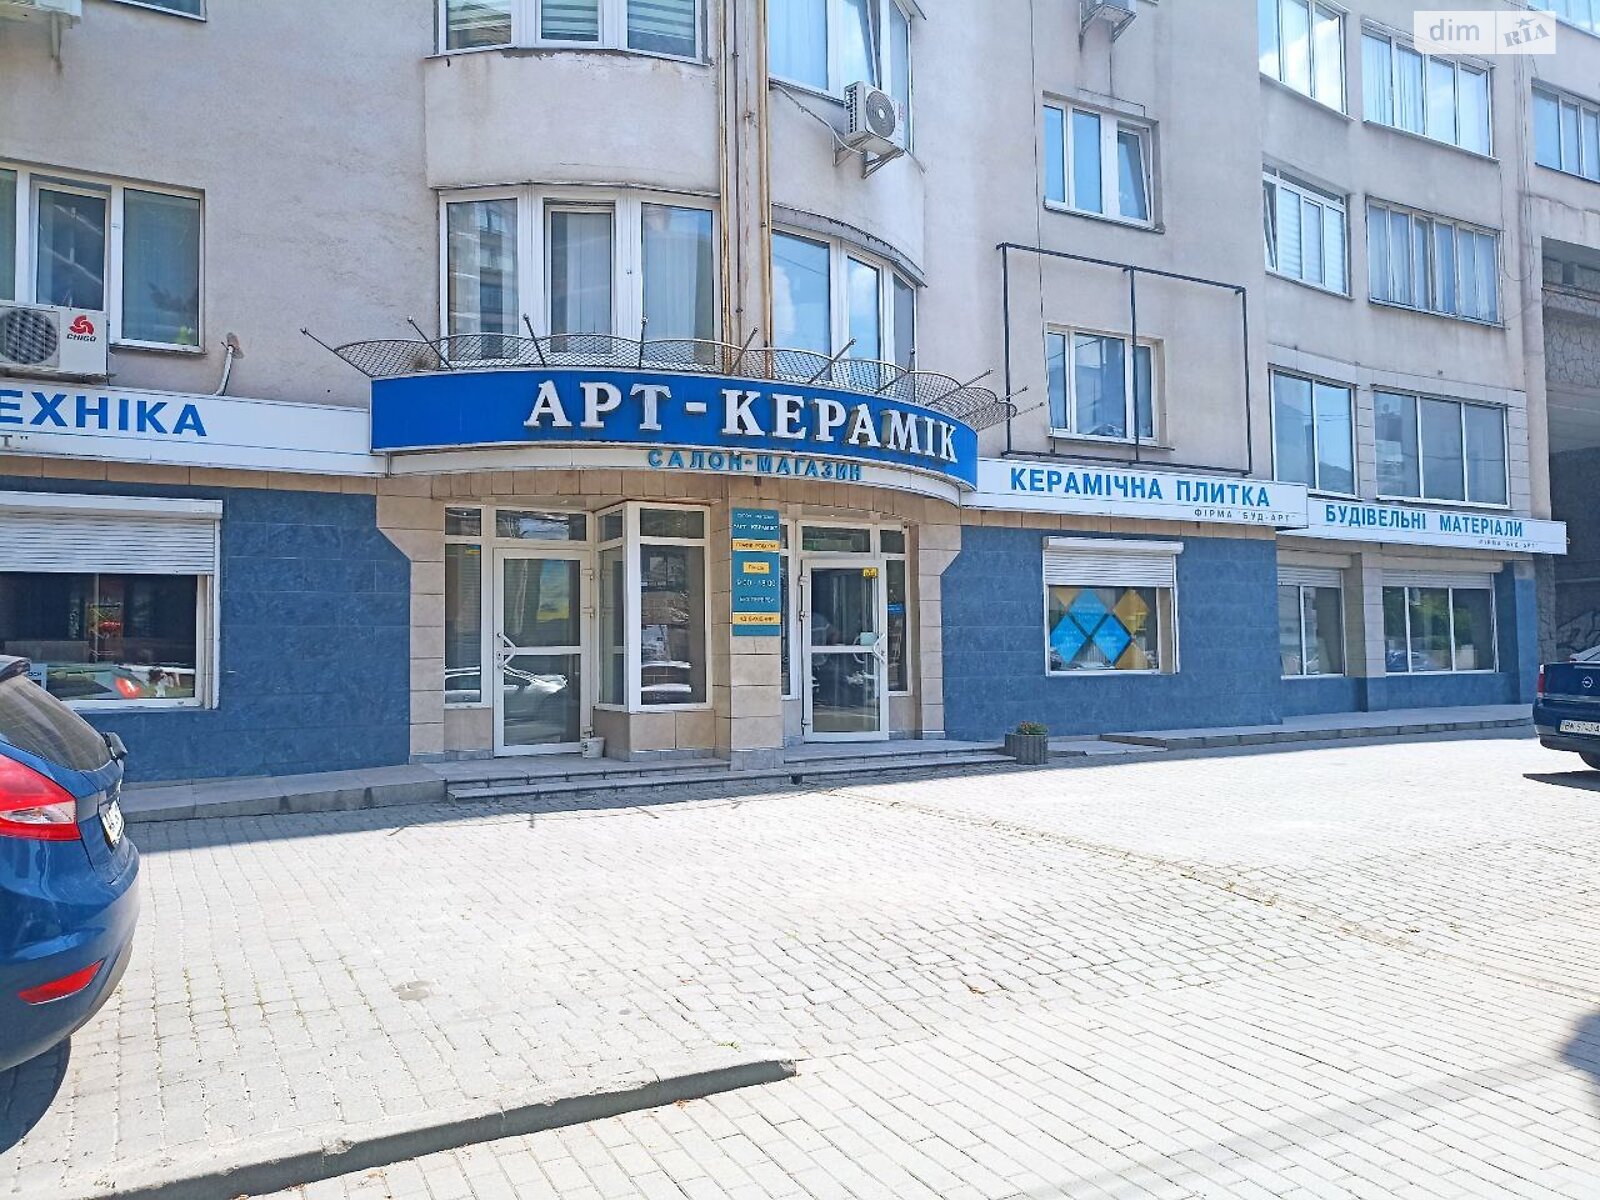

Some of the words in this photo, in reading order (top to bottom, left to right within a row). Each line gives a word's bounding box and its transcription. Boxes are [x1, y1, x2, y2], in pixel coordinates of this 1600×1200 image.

[66, 333, 97, 342] CHIGO
[648, 448, 863, 481] САЛОН-МАГАЗИН
[1010, 466, 1163, 501] КЕРАМІЧНА
[1176, 479, 1271, 507] ПЛИТКА
[1194, 508, 1233, 518] ФІРМА
[1325, 504, 1426, 530] БУДІВЕЛЬНІ
[1439, 514, 1524, 538] МАТЕРІАЛИ
